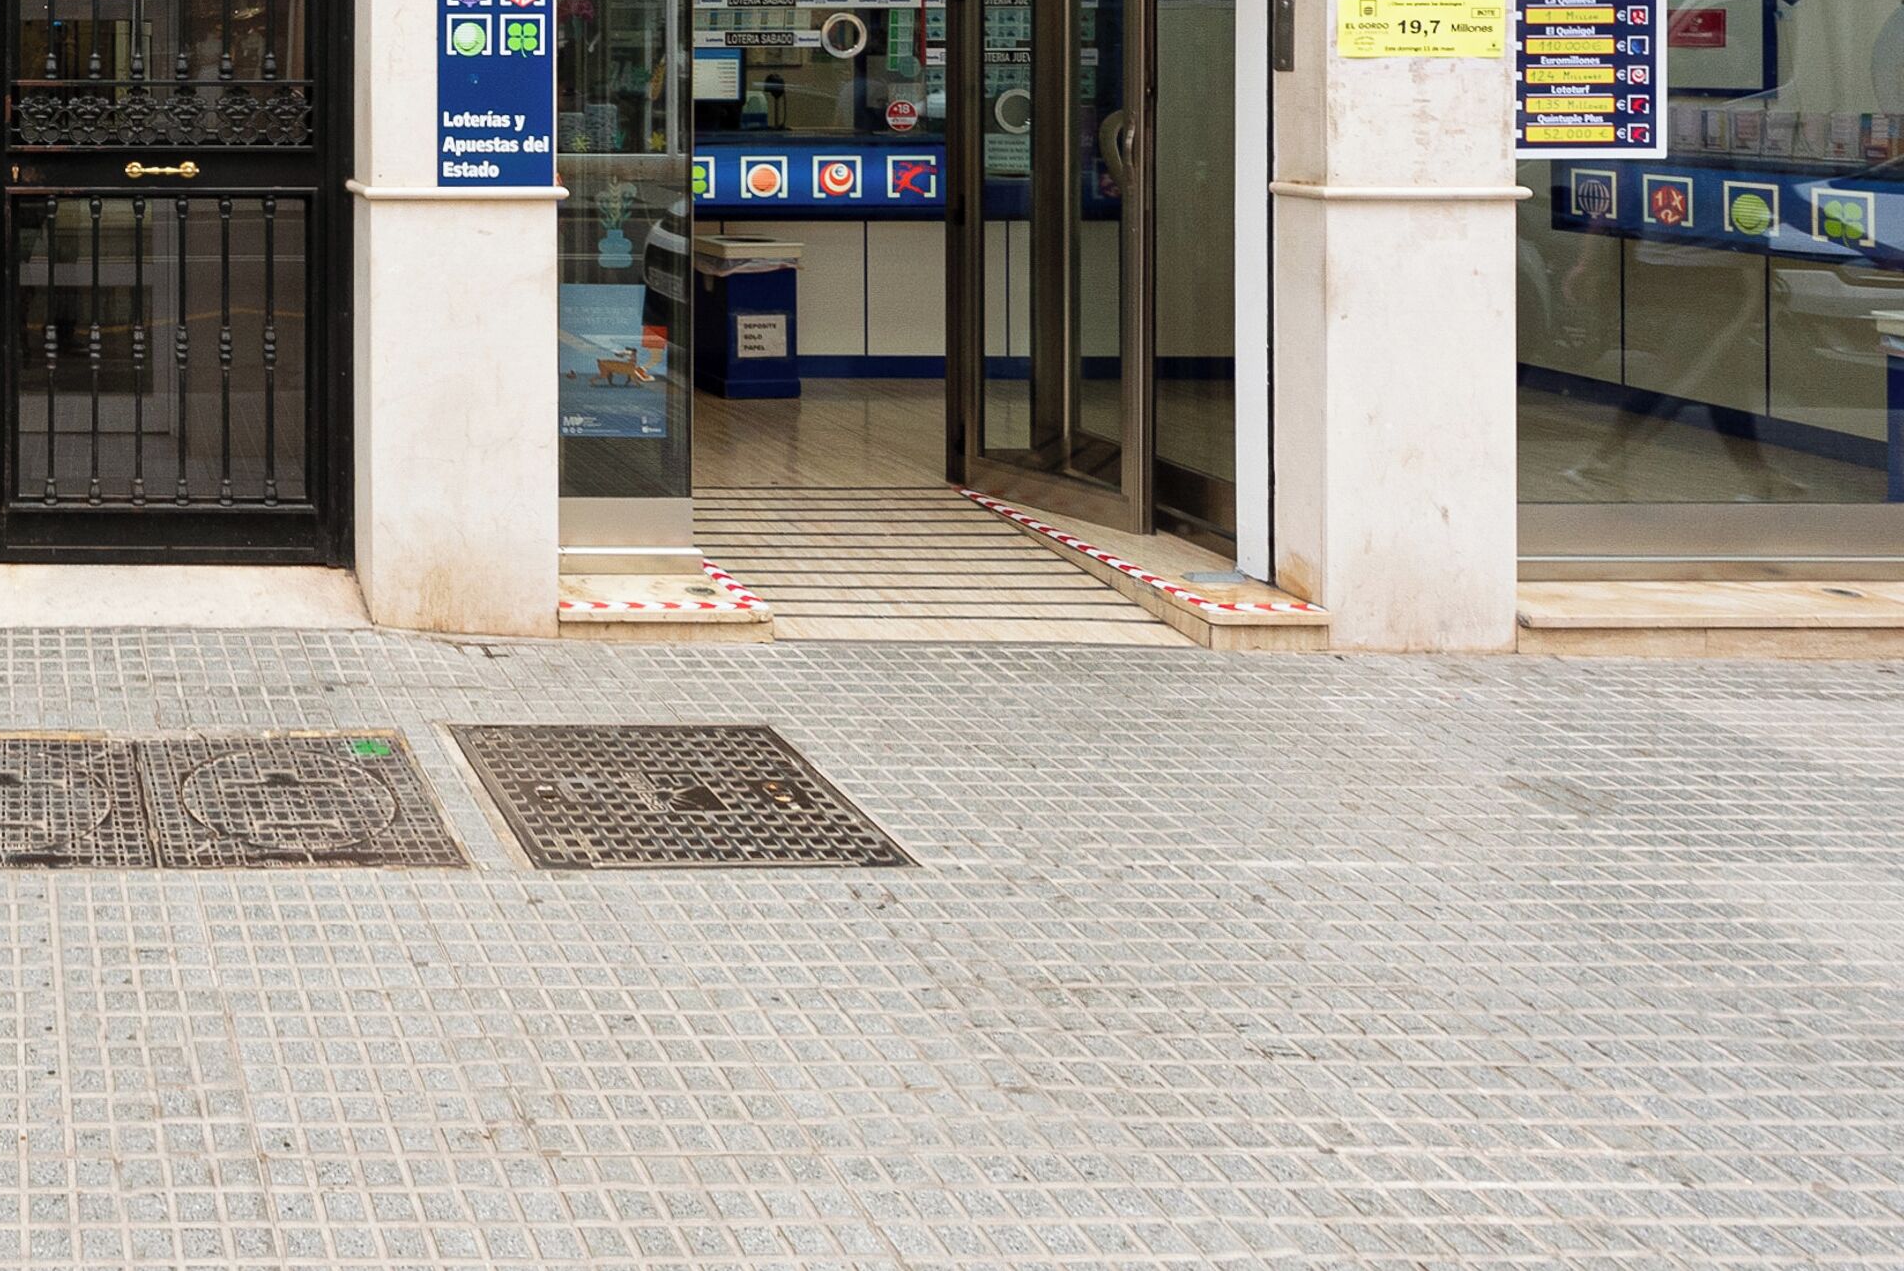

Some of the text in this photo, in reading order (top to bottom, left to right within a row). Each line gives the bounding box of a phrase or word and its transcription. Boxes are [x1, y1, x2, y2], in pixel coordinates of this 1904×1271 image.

[1397, 20, 1493, 37] 19,7 Millones
[1546, 26, 1595, 37] El Quinigol
[726, 33, 793, 45] LOTERIA SABADO
[1540, 56, 1600, 65] Euromillones
[1551, 85, 1590, 94] Lototurf
[442, 111, 526, 131] Loterías y
[1584, 114, 1604, 122] Plus
[442, 136, 549, 156] Apuestas del
[442, 161, 499, 178] Estado
